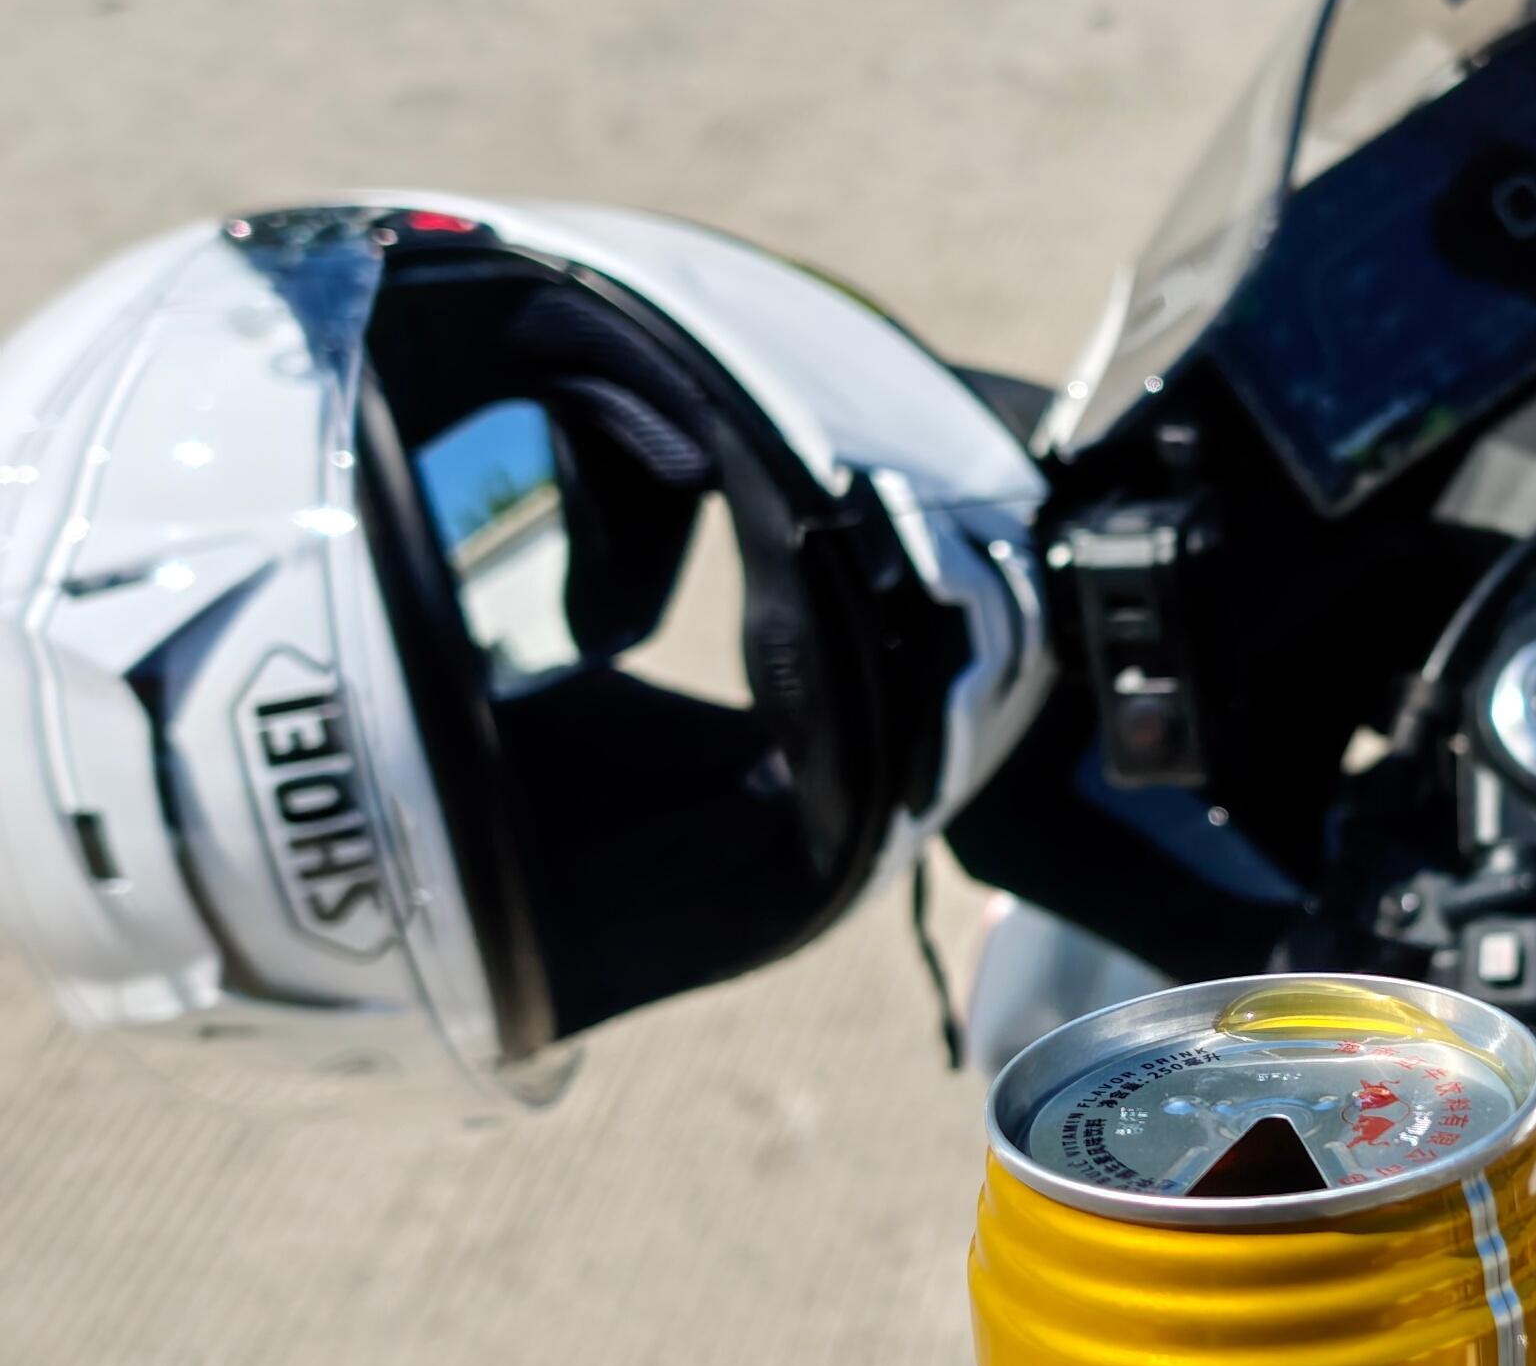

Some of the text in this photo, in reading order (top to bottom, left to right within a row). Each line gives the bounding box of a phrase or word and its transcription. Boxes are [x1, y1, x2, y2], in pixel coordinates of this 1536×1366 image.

[255, 694, 383, 924] SHOEI
[1061, 1112, 1084, 1158] VITAMIN
[1077, 1071, 1137, 1109] FLAVOR
[1141, 1047, 1209, 1071] DRINK
